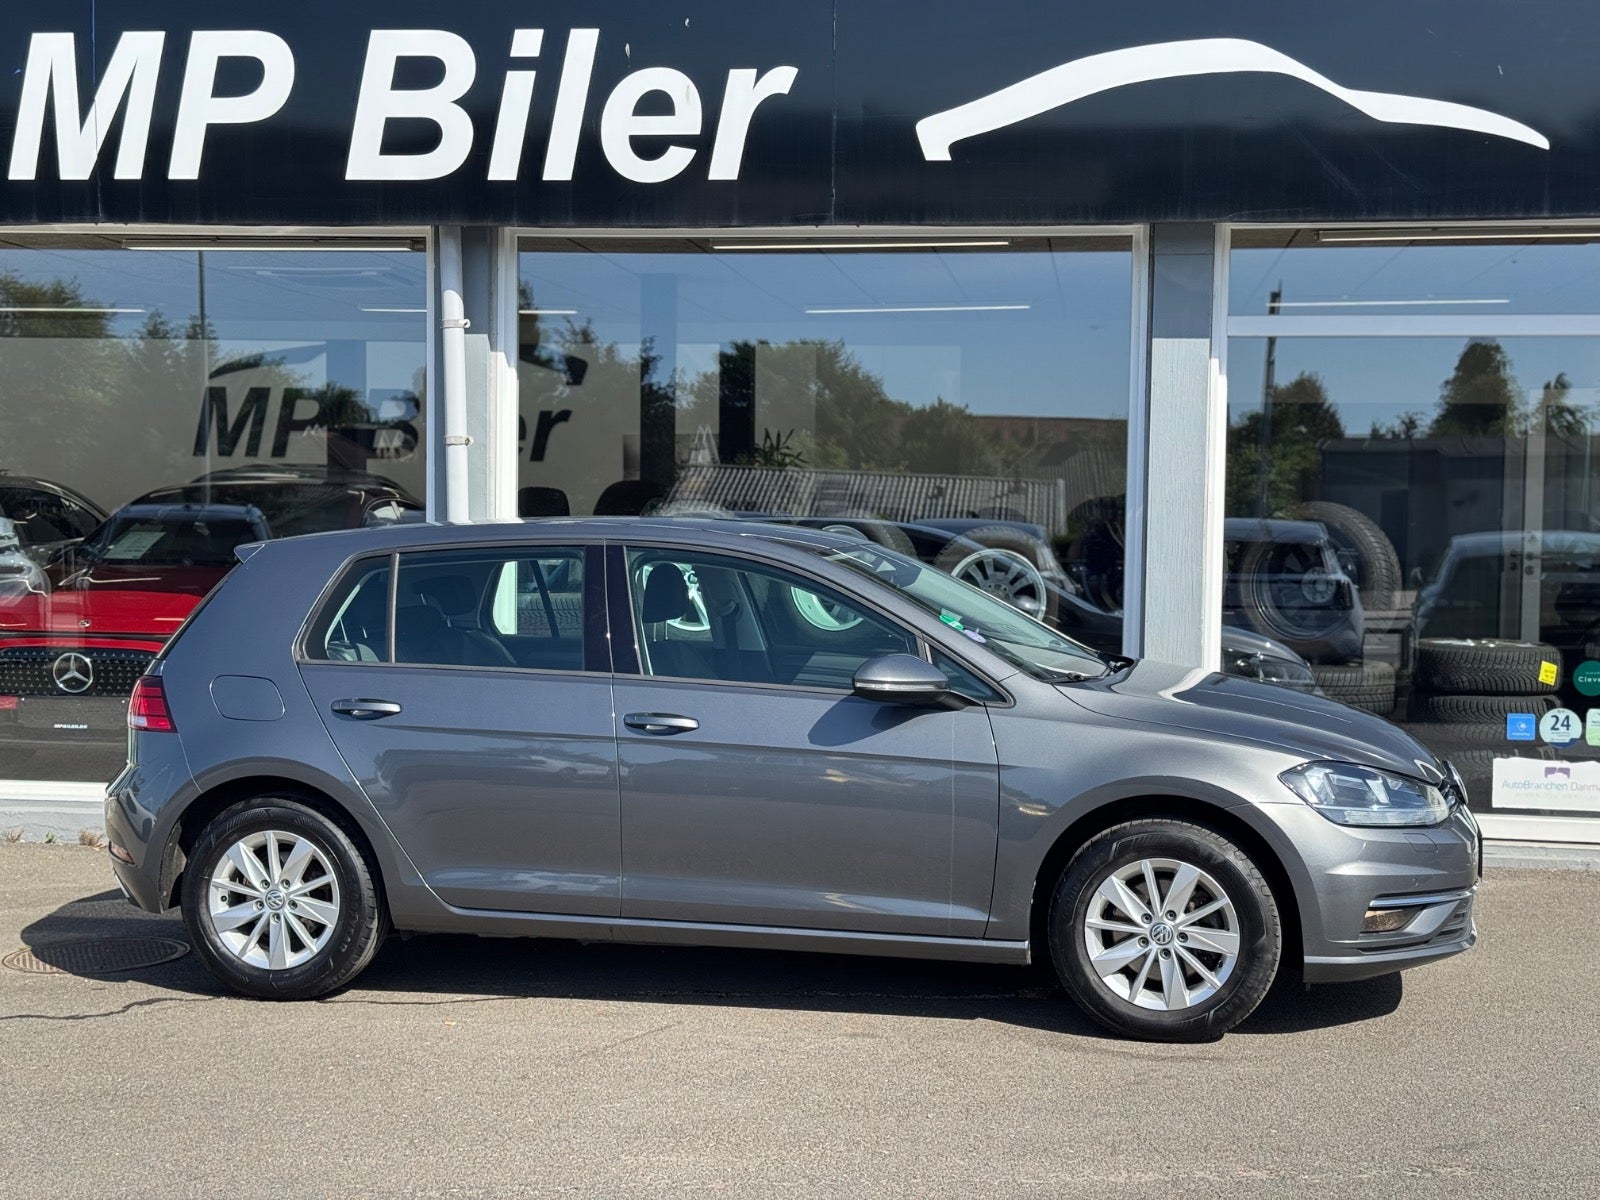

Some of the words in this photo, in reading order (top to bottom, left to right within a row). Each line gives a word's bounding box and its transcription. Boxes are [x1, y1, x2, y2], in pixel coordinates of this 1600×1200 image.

[8, 29, 295, 181] MP
[344, 28, 797, 184] Biler
[193, 386, 321, 458] MP
[1550, 715, 1571, 731] 24
[1502, 780, 1568, 792] AutoBranchen
